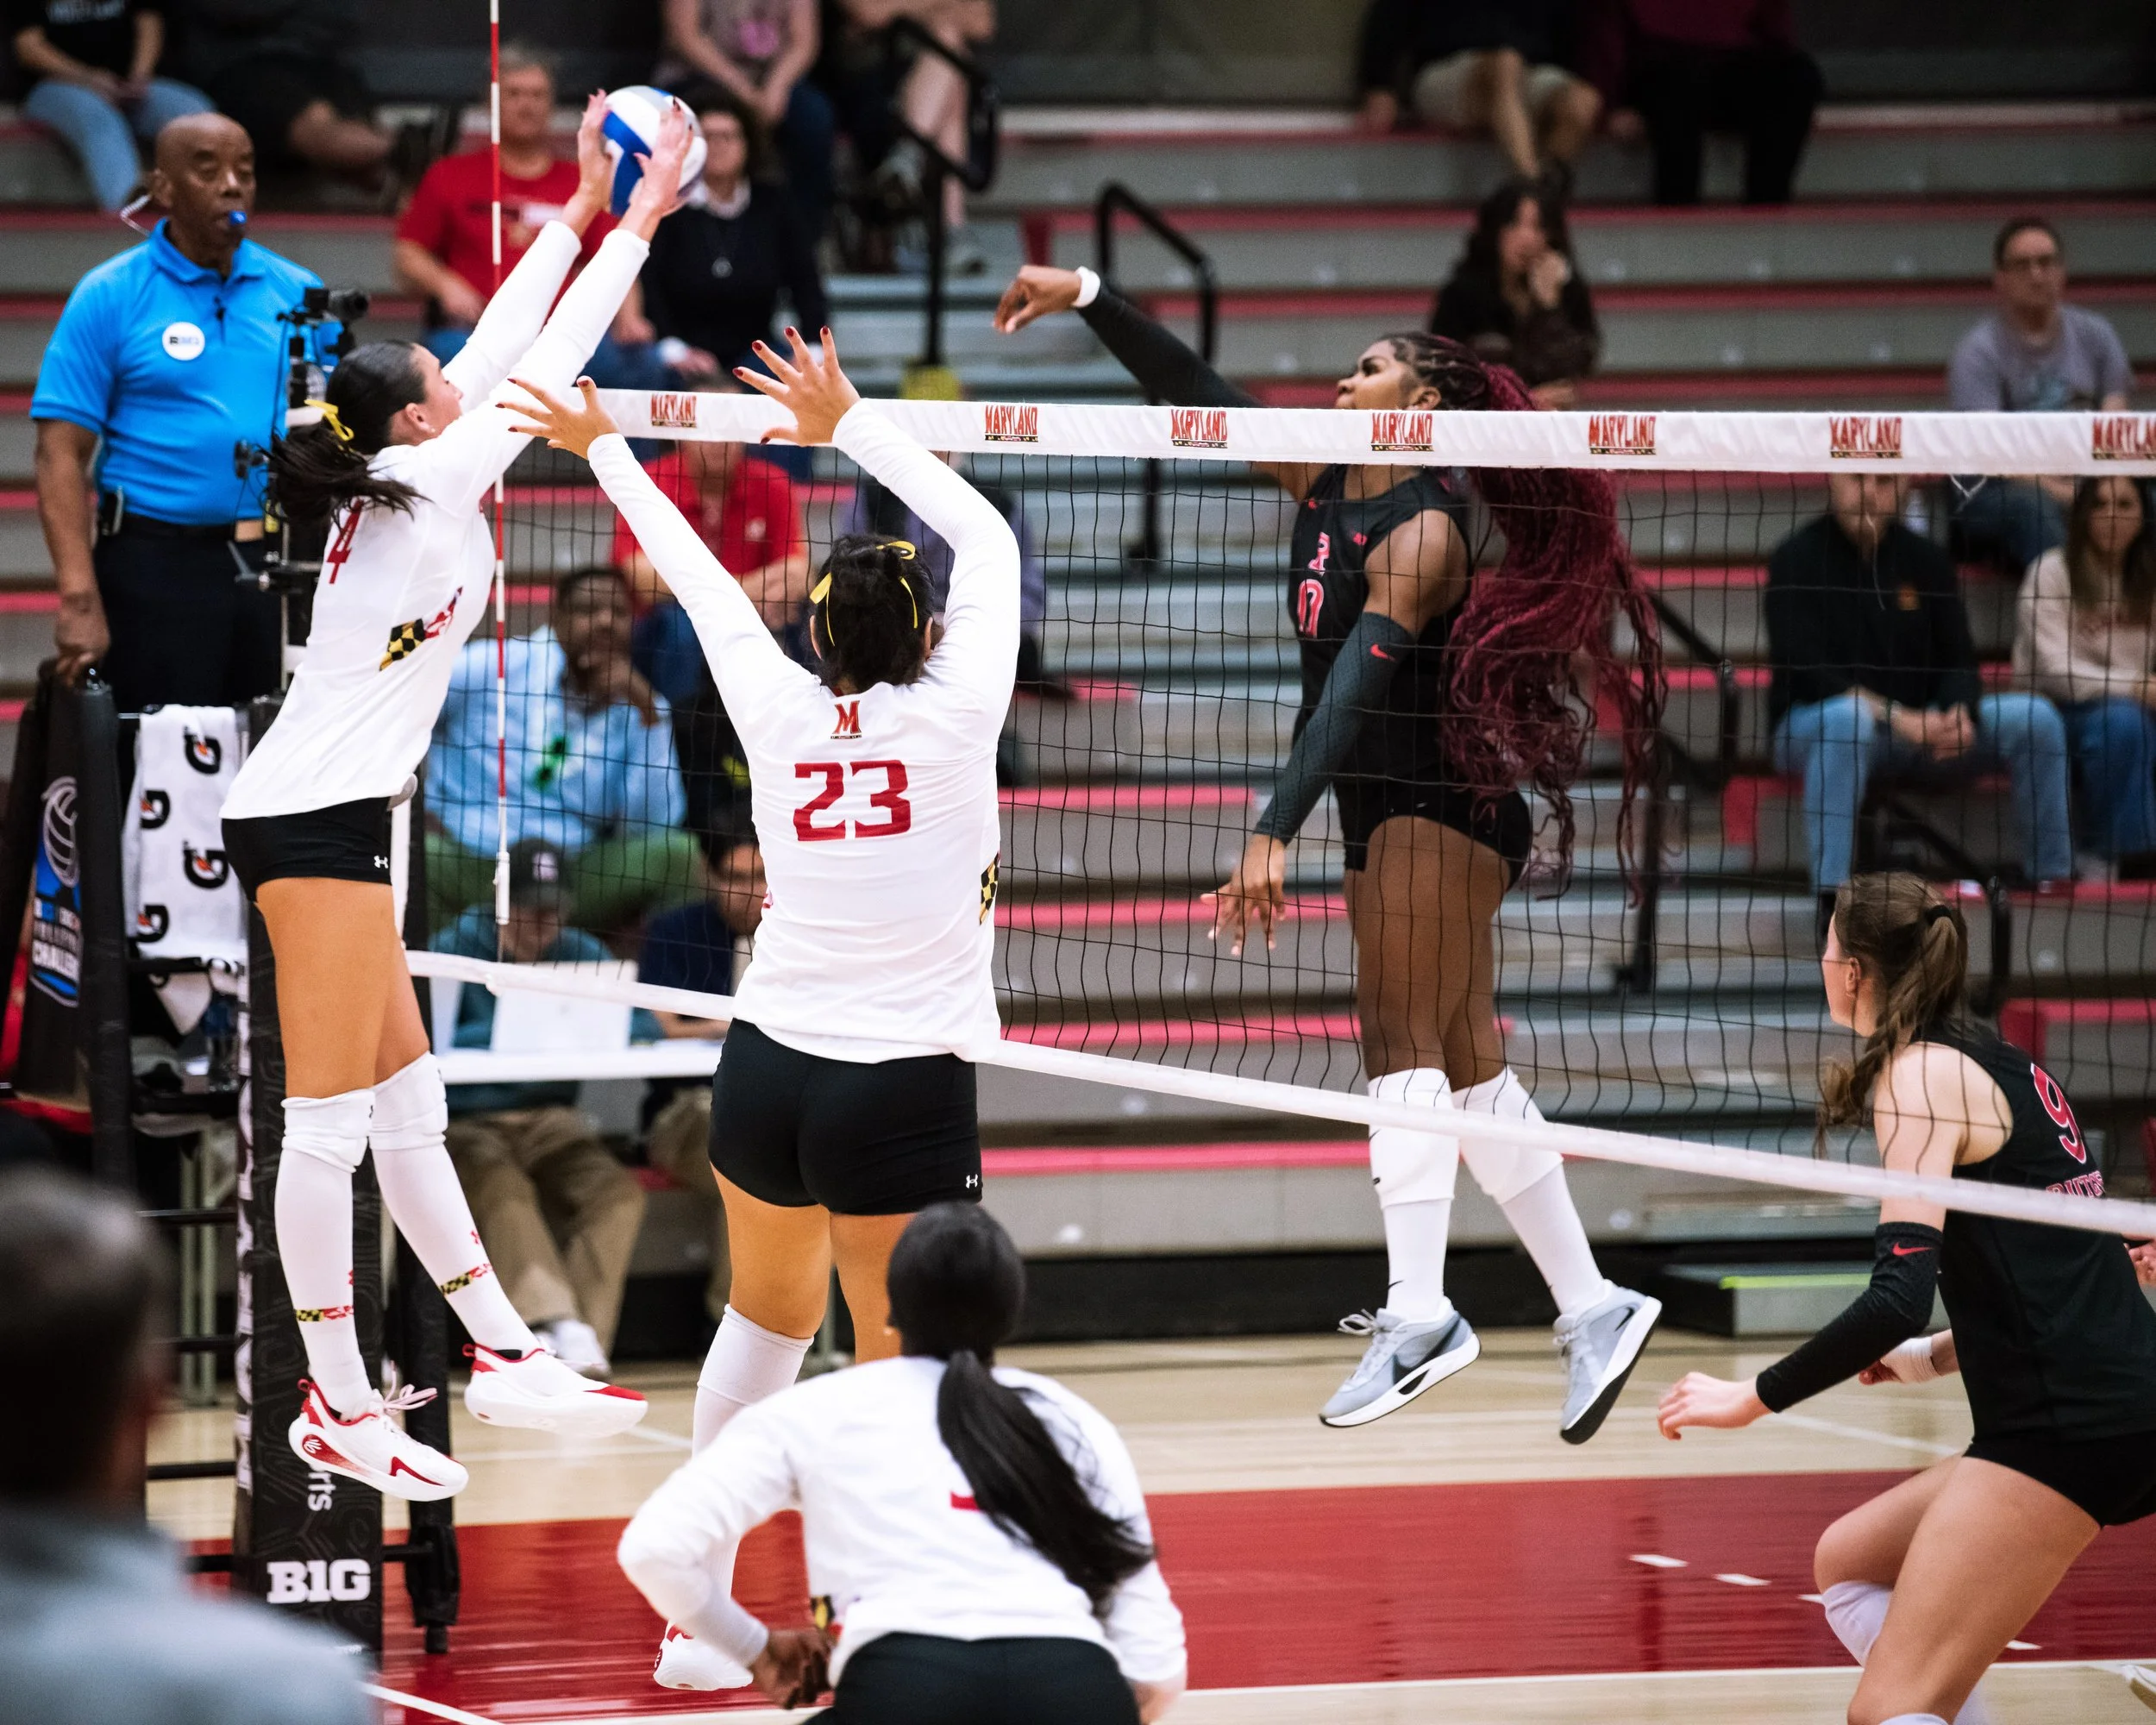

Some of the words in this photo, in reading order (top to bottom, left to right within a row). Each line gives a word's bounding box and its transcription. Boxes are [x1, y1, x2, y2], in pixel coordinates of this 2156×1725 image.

[985, 405, 1038, 435] MARYLAND
[1171, 409, 1228, 441] MARYLAND
[1371, 412, 1432, 444] MARYLAND
[1589, 415, 1656, 448] MARYLAND
[1829, 417, 1902, 450] MARYLAND
[2093, 417, 2156, 453] MARYLA
[832, 700, 862, 734] M
[793, 760, 911, 841] 23
[2031, 1063, 2086, 1164] 9
[308, 1465, 336, 1511] rts
